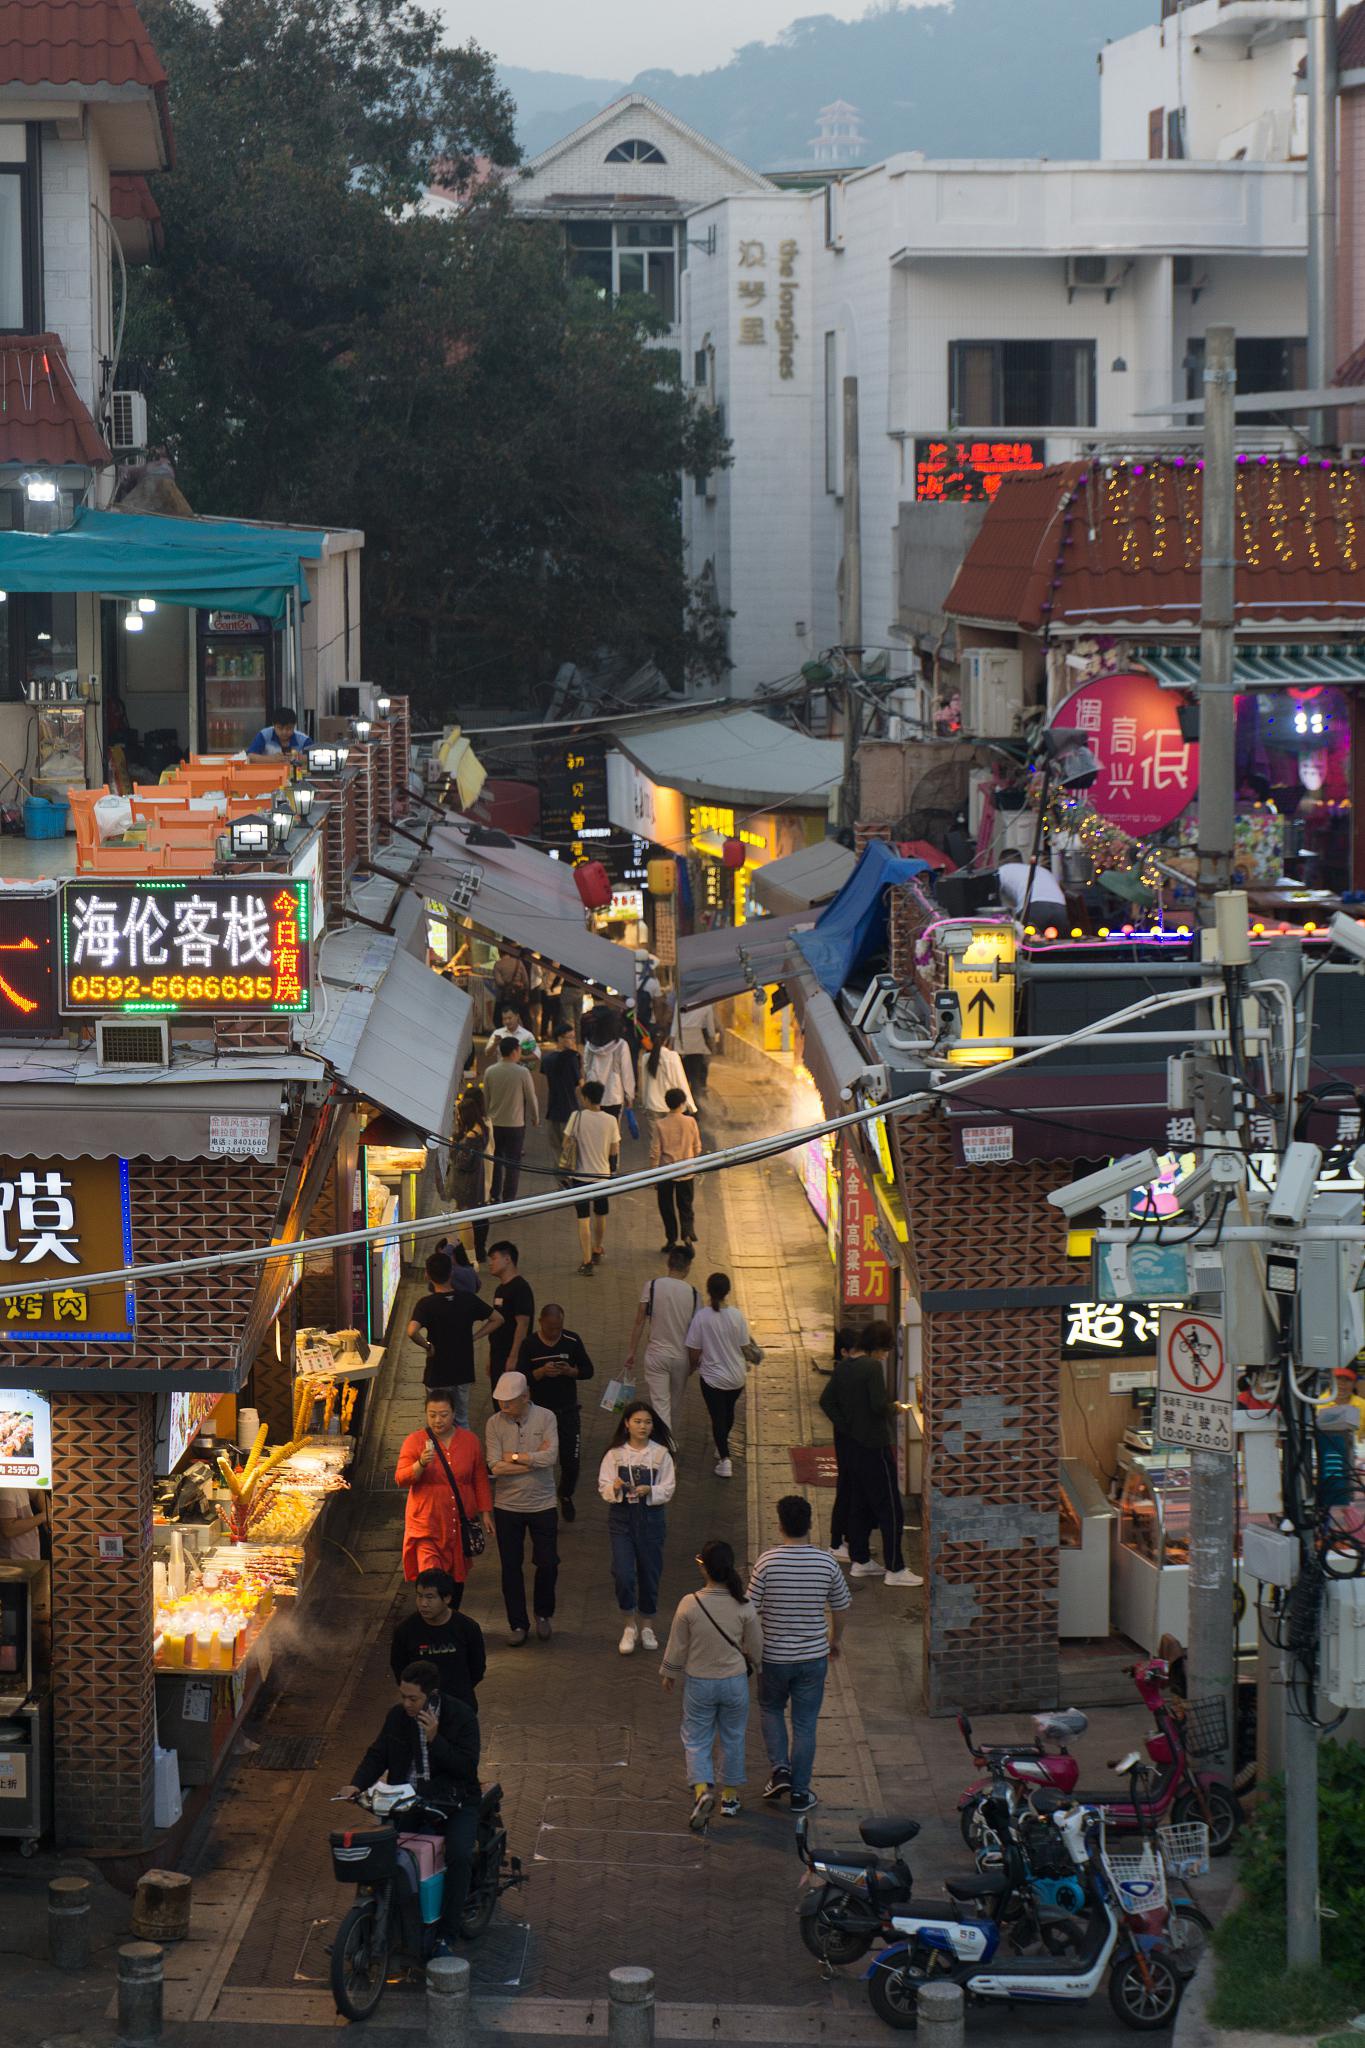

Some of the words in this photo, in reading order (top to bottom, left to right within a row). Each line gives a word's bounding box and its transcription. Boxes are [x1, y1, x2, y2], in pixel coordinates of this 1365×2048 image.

[779, 239, 799, 277] the
[775, 282, 799, 381] longines
[1108, 716, 1137, 800] 高兴
[1141, 729, 1189, 790] 很
[72, 895, 272, 967] 海伦客栈
[273, 890, 300, 1001] 今日有房
[71, 975, 272, 1000] 0592-5666635
[0, 1172, 81, 1264] 馍
[4, 1288, 88, 1321] 烤肉
[1162, 1426, 1229, 1447] 10:00-20:00
